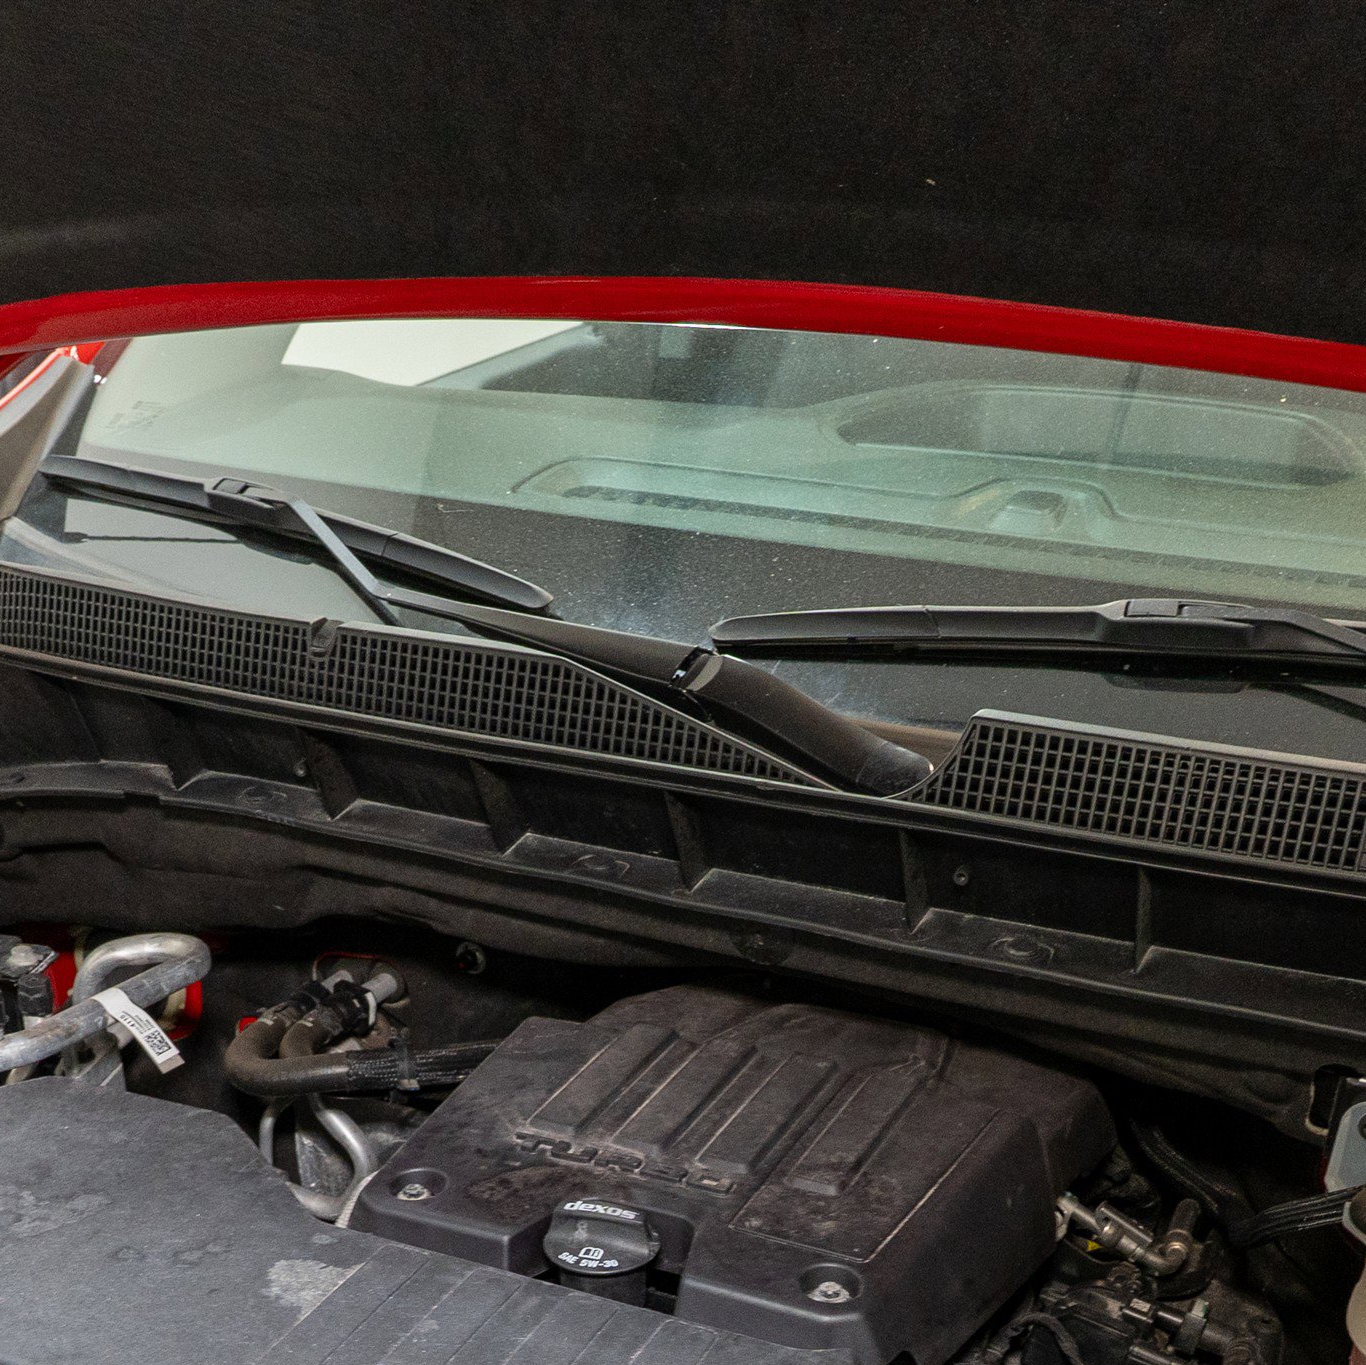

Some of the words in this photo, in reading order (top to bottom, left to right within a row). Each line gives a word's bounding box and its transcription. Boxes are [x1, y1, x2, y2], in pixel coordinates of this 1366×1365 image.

[514, 1131, 734, 1196] TURBO
[564, 1201, 639, 1219] dexos
[557, 1252, 579, 1264] SAE
